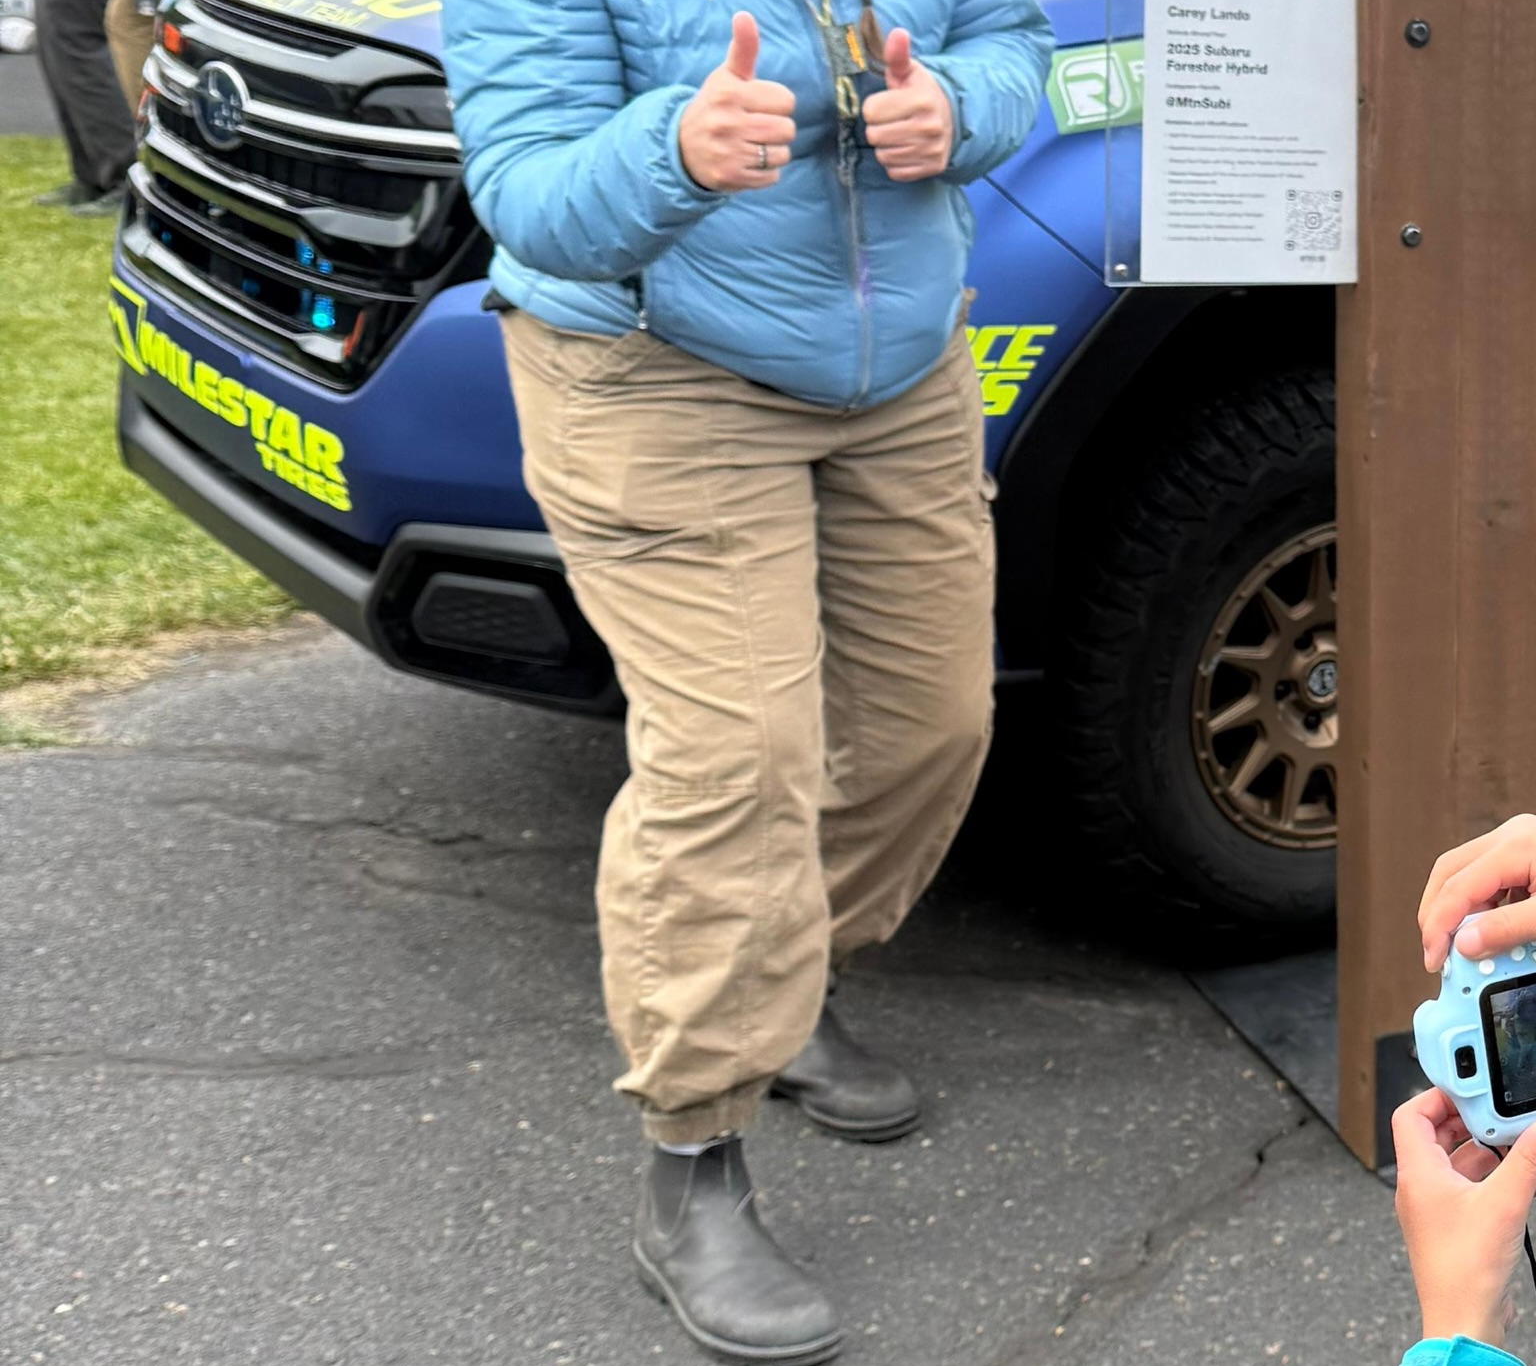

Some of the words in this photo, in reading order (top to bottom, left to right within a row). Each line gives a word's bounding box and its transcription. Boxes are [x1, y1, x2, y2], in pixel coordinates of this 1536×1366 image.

[1167, 6, 1206, 22] Carey
[1210, 8, 1251, 21] Lando
[1166, 43, 1200, 56] 2025
[1204, 44, 1251, 58] Subaru
[1166, 60, 1222, 73] Forester
[1226, 62, 1268, 76] Hybrid
[1165, 96, 1231, 110] @MtnSubi
[138, 320, 347, 485] MILESTAR
[256, 442, 352, 511] TIRES
